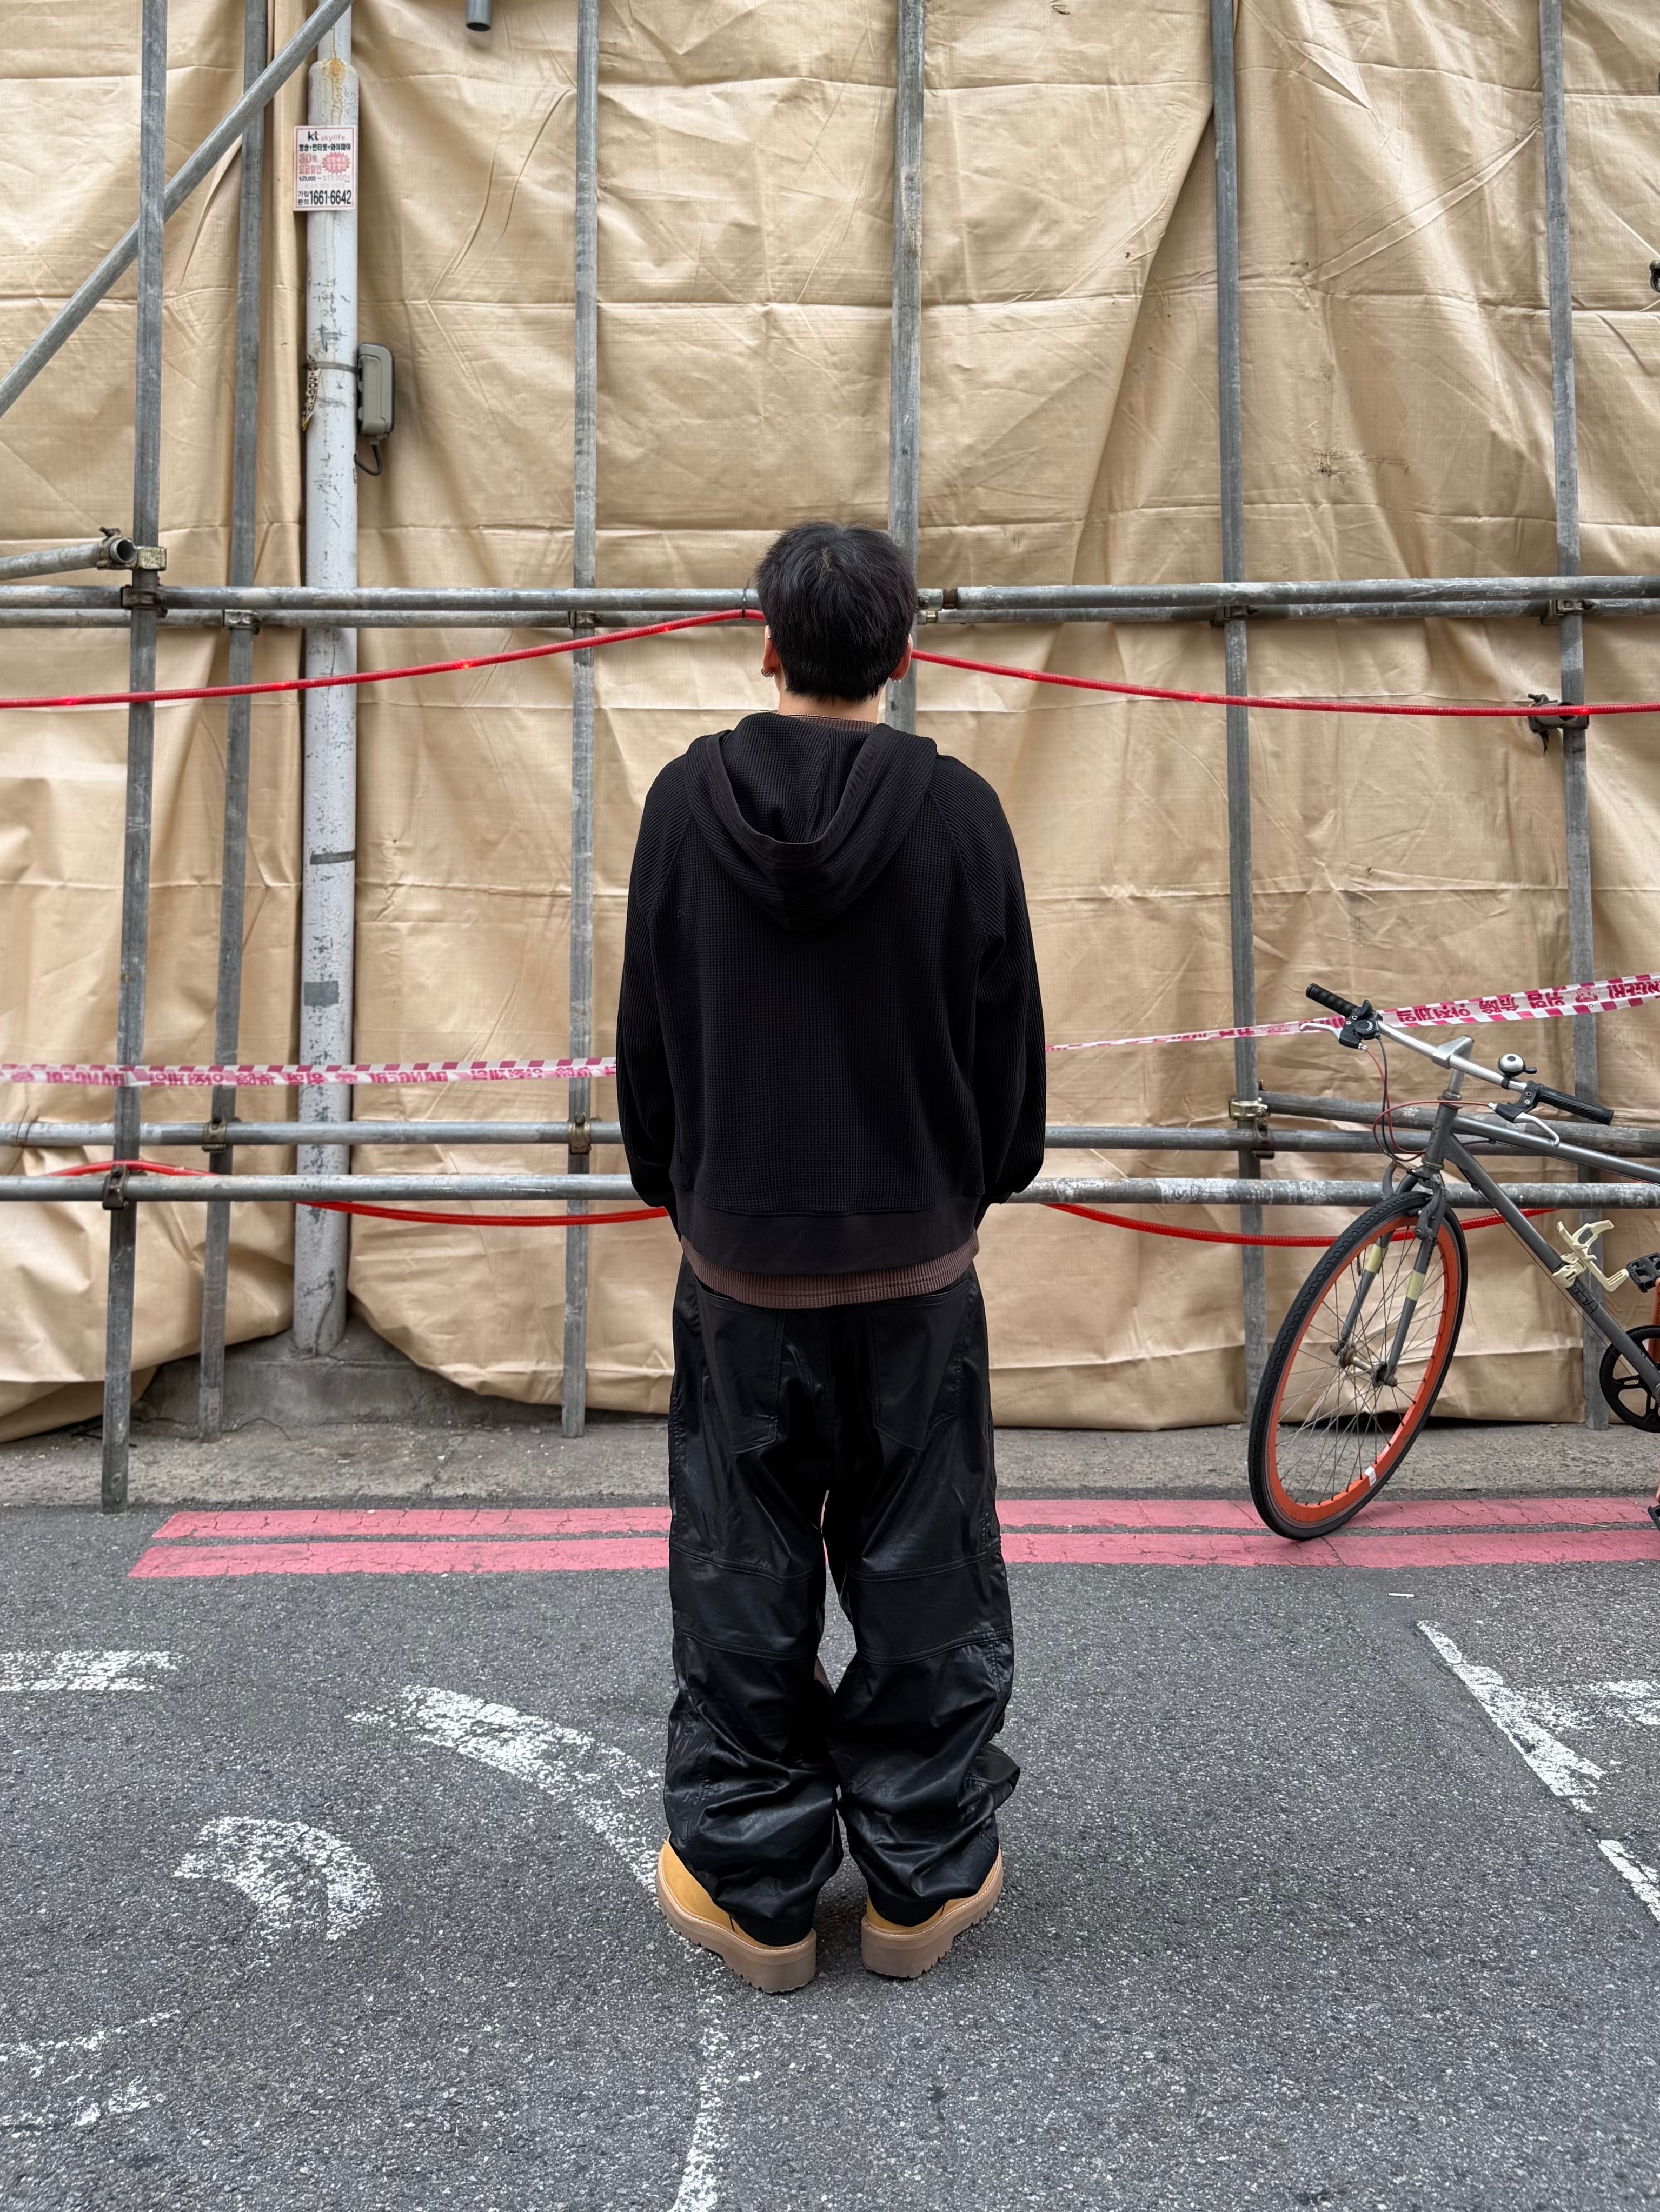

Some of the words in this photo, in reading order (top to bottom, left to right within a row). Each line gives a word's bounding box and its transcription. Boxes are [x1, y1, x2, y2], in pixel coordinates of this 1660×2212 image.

[308, 131, 319, 141] kt
[1606, 981, 1660, 999] NGER!
[1526, 991, 1565, 1009] 위험
[1396, 1004, 1470, 1022] 안전제일
